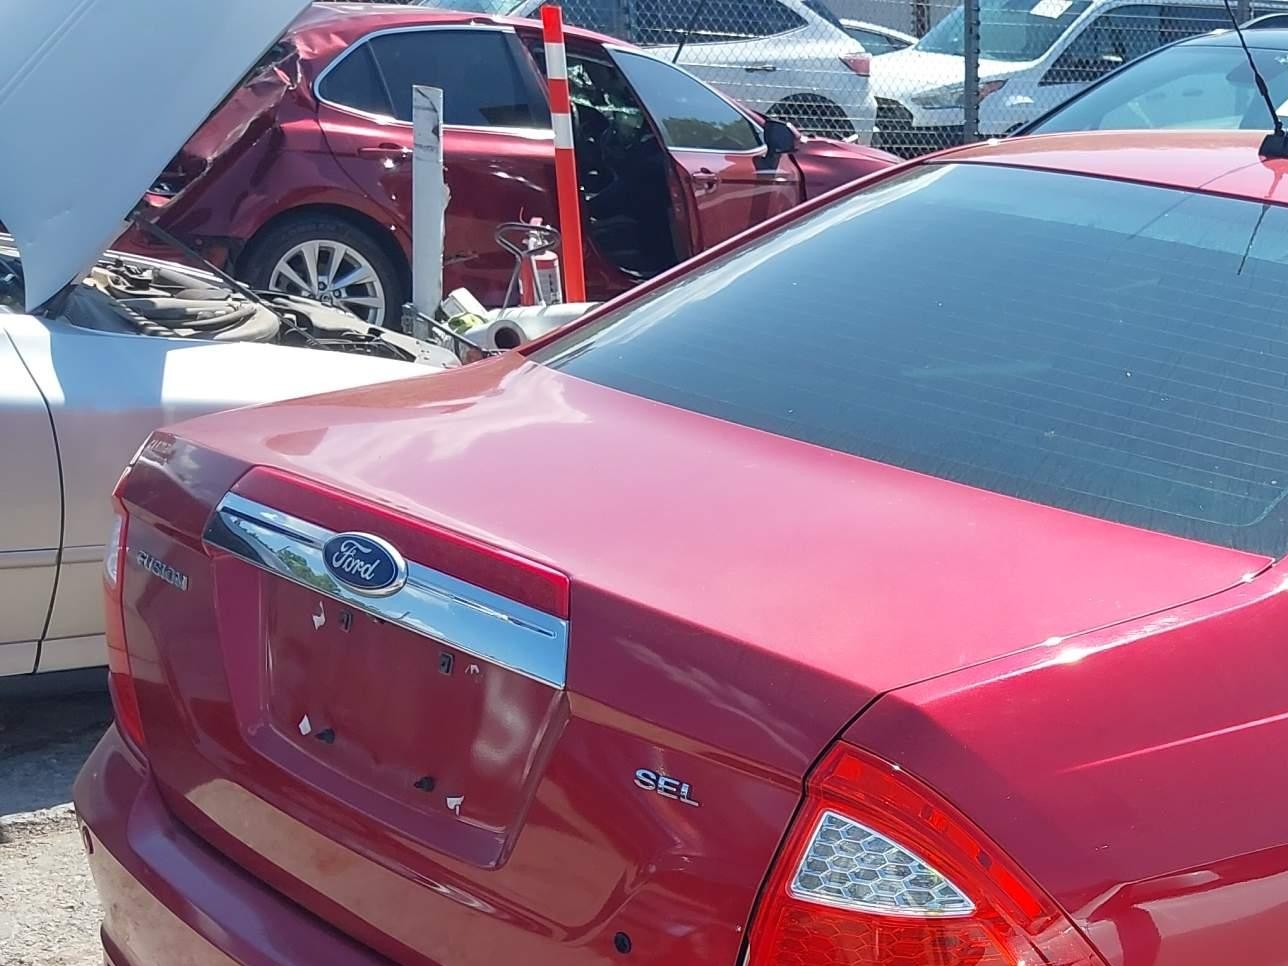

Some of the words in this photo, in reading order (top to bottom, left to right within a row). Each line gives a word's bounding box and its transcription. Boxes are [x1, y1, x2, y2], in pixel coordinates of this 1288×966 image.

[136, 550, 188, 592] FUSION
[332, 539, 379, 580] Ford
[633, 768, 699, 807] SEL
